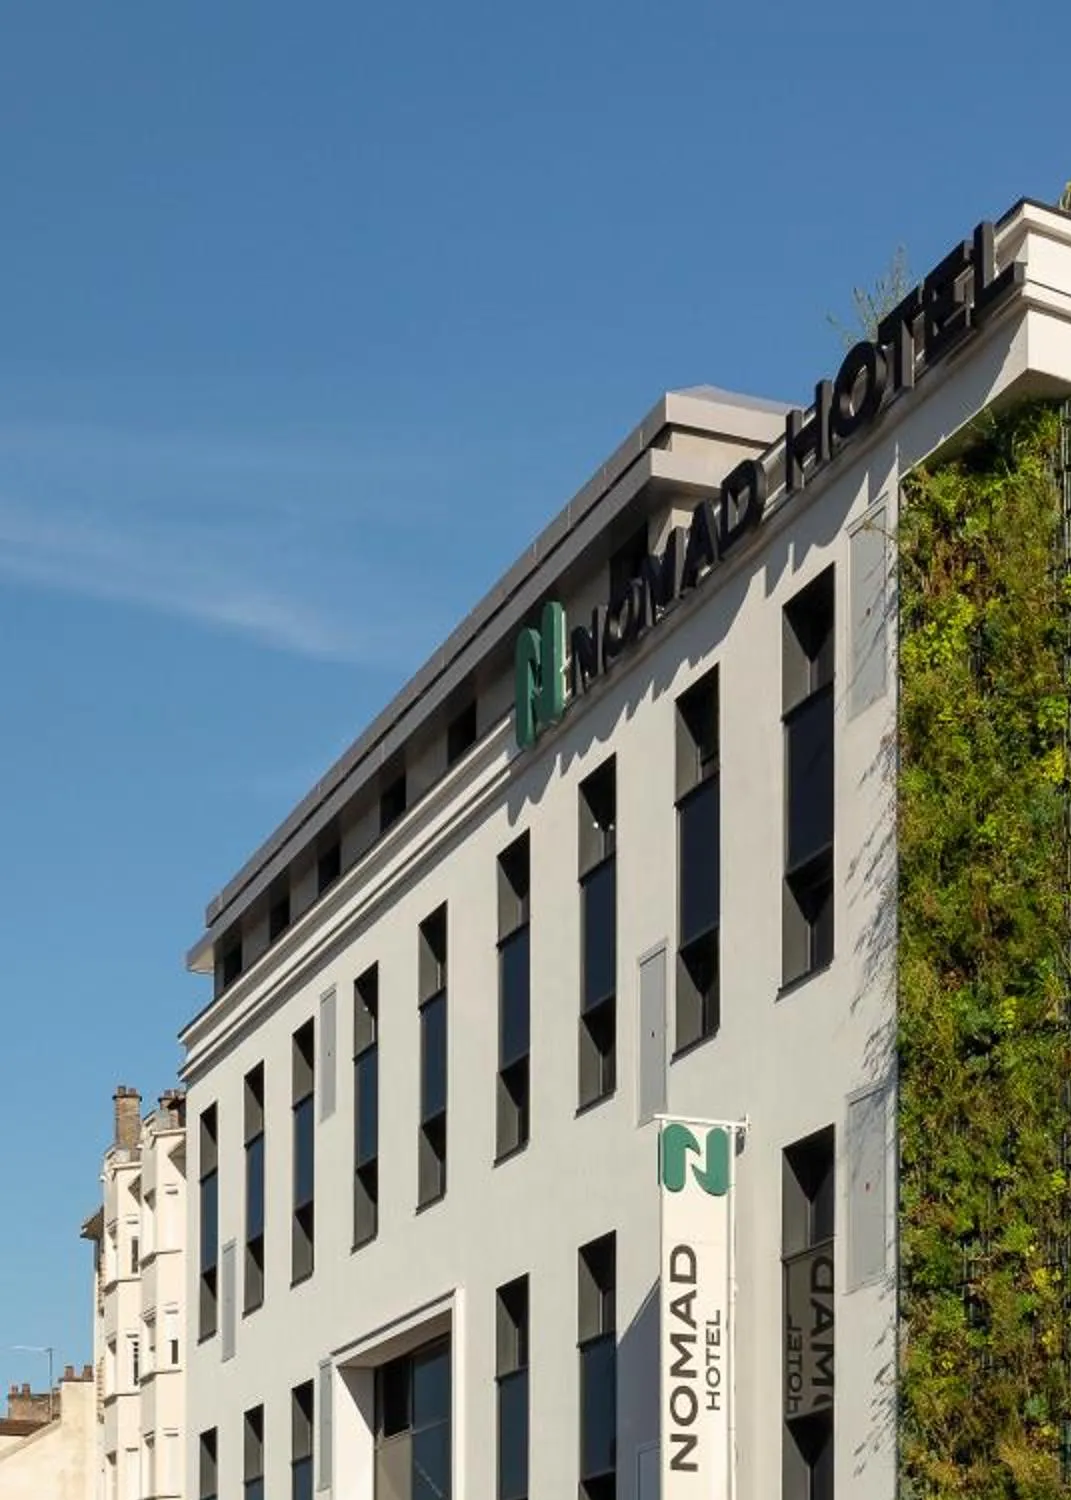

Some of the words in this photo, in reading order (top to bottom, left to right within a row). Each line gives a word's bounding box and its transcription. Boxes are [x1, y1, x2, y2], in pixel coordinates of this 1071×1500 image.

[571, 459, 768, 697] NOMAD
[785, 221, 1028, 491] HOTEL
[669, 1243, 699, 1472] NOMAD
[705, 1308, 722, 1411] HOTEL
